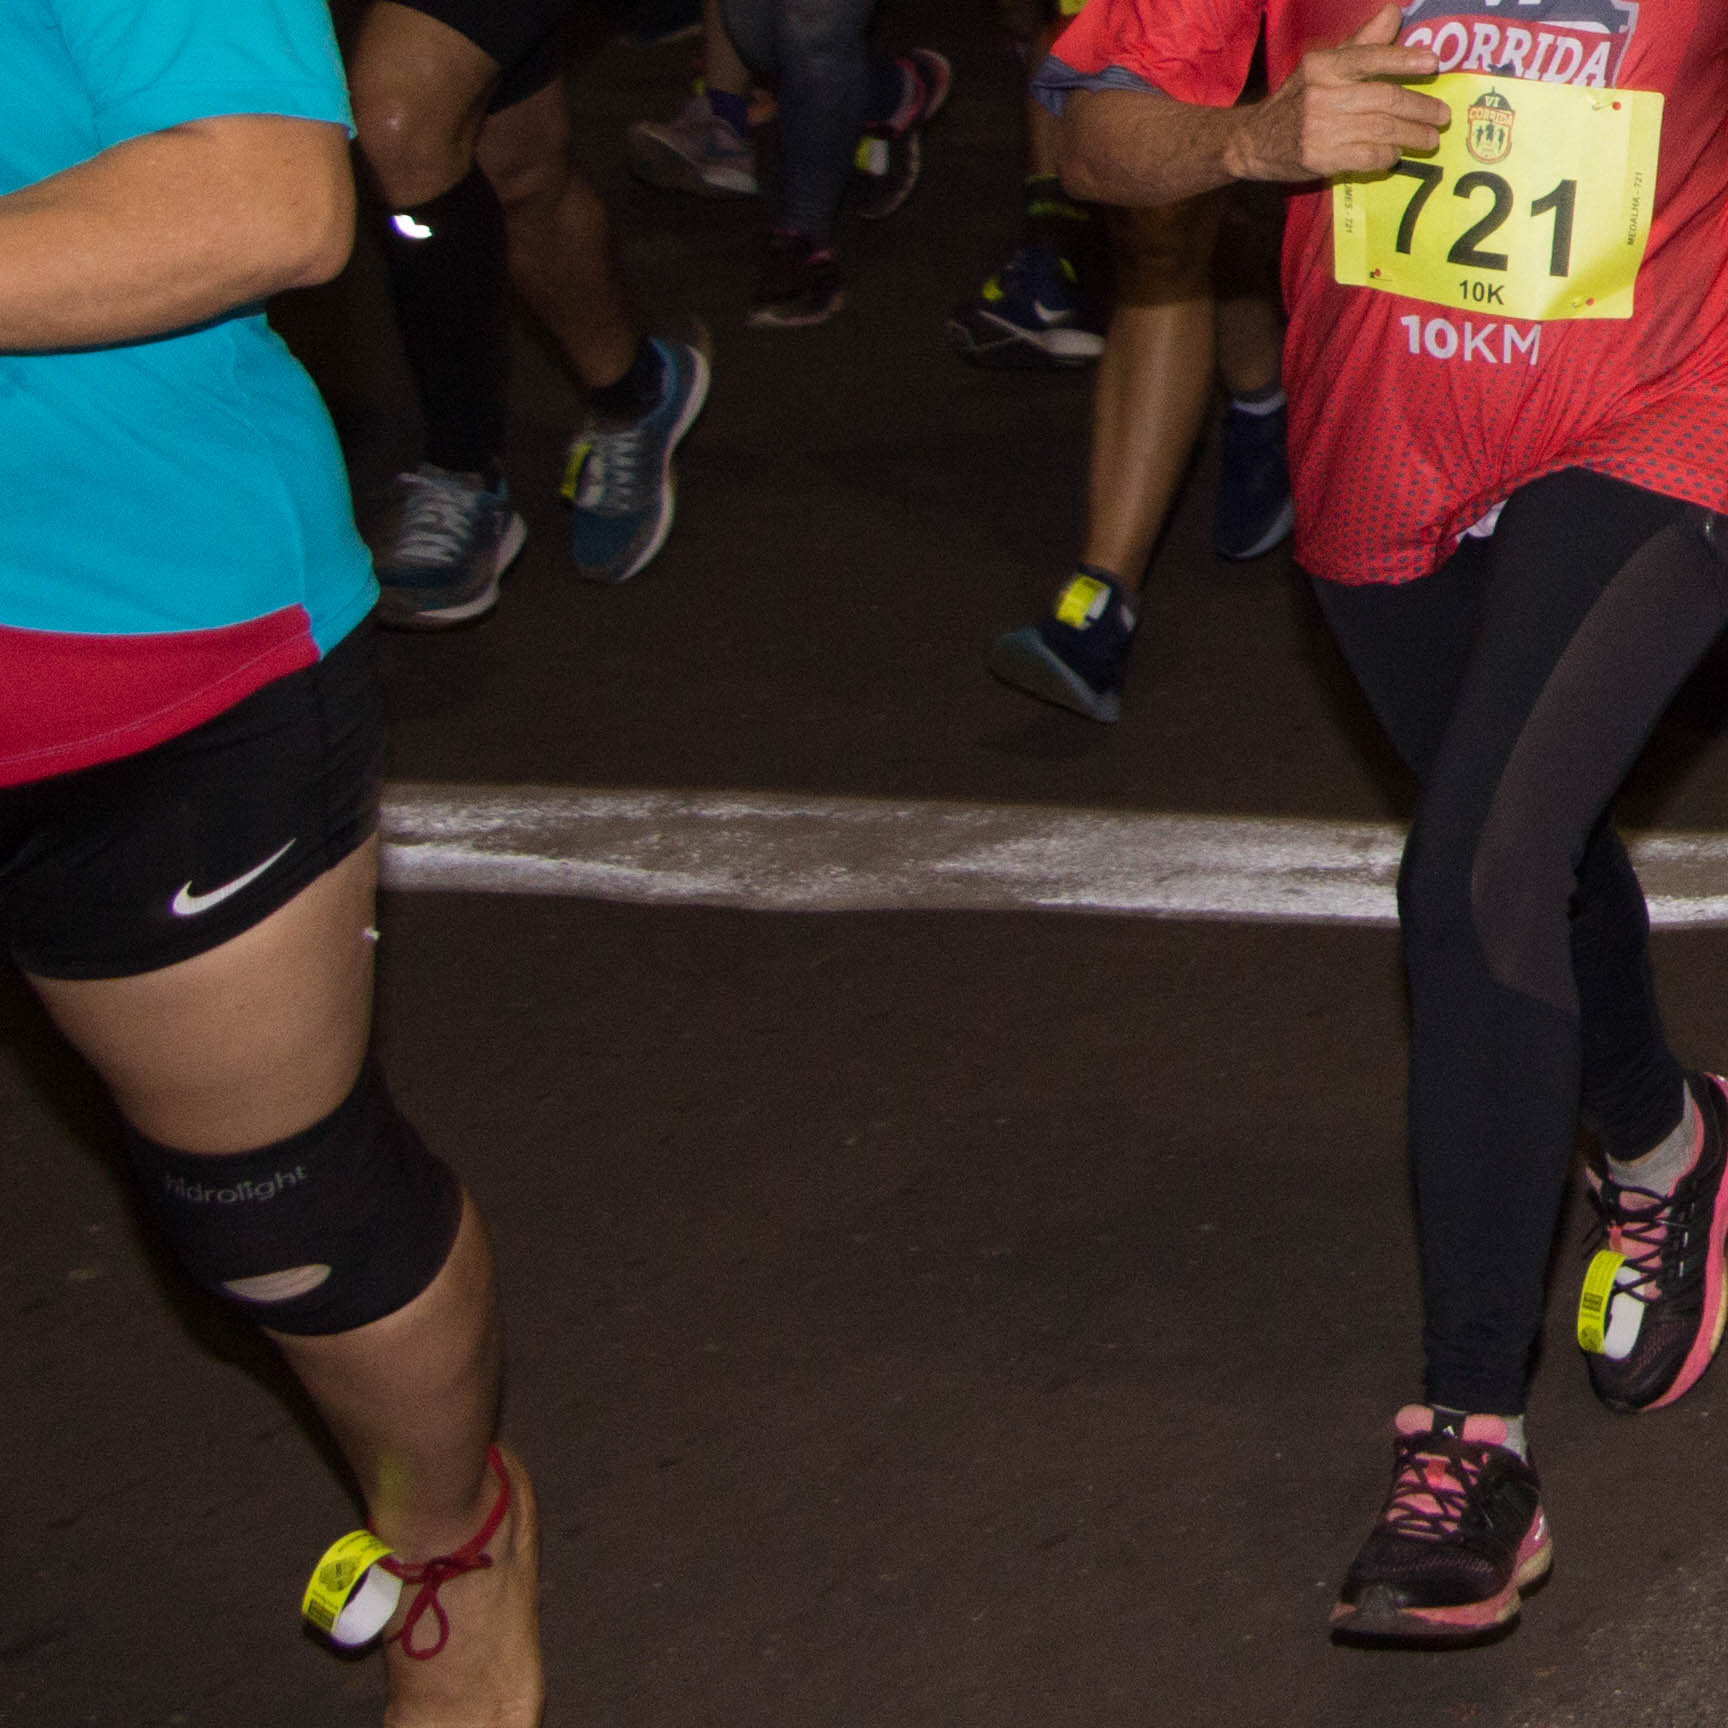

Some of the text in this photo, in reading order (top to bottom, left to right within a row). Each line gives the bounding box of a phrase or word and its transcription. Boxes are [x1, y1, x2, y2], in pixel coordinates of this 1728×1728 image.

[1404, 20, 1613, 90] CORRIDA
[1484, 95, 1501, 108] VI
[1388, 158, 1579, 278] 721
[1459, 280, 1505, 306] 10K
[1400, 316, 1542, 368] 10KM
[165, 1165, 308, 1204] hidrolight
